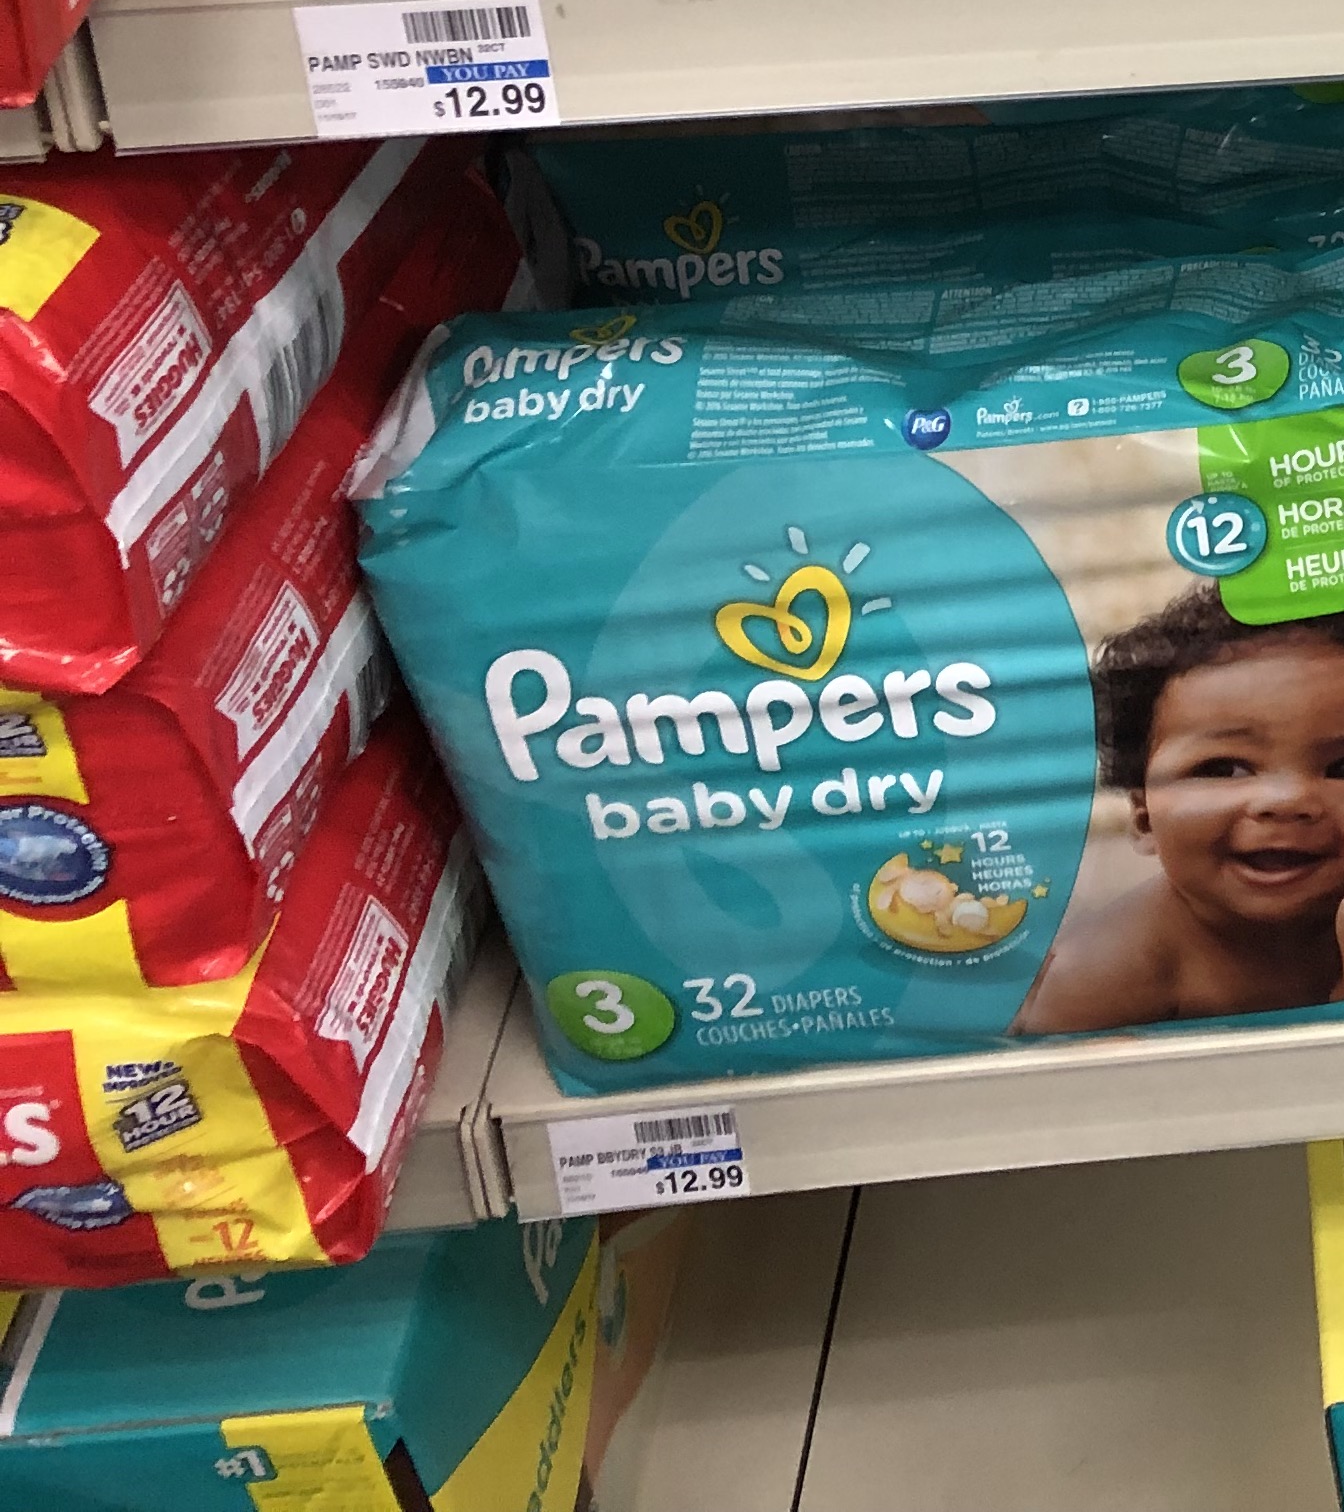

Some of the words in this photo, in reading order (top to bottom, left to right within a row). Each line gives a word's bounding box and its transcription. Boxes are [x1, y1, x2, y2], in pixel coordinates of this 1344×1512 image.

[308, 54, 362, 72] PAMP
[368, 51, 411, 69] SWD
[416, 48, 473, 65] NWBN
[434, 83, 546, 118] $12.99
[577, 237, 787, 304] Pampers
[1210, 345, 1259, 387] 3
[463, 387, 571, 425] baby
[578, 379, 647, 414] dry
[1185, 512, 1248, 558] 12
[485, 647, 998, 782] Pampers
[584, 781, 794, 842] baby
[811, 766, 945, 816] dry
[574, 979, 637, 1034] 3
[682, 972, 764, 1024] 32
[770, 984, 864, 1015] DIAPERS
[656, 1165, 744, 1195] $12.99
